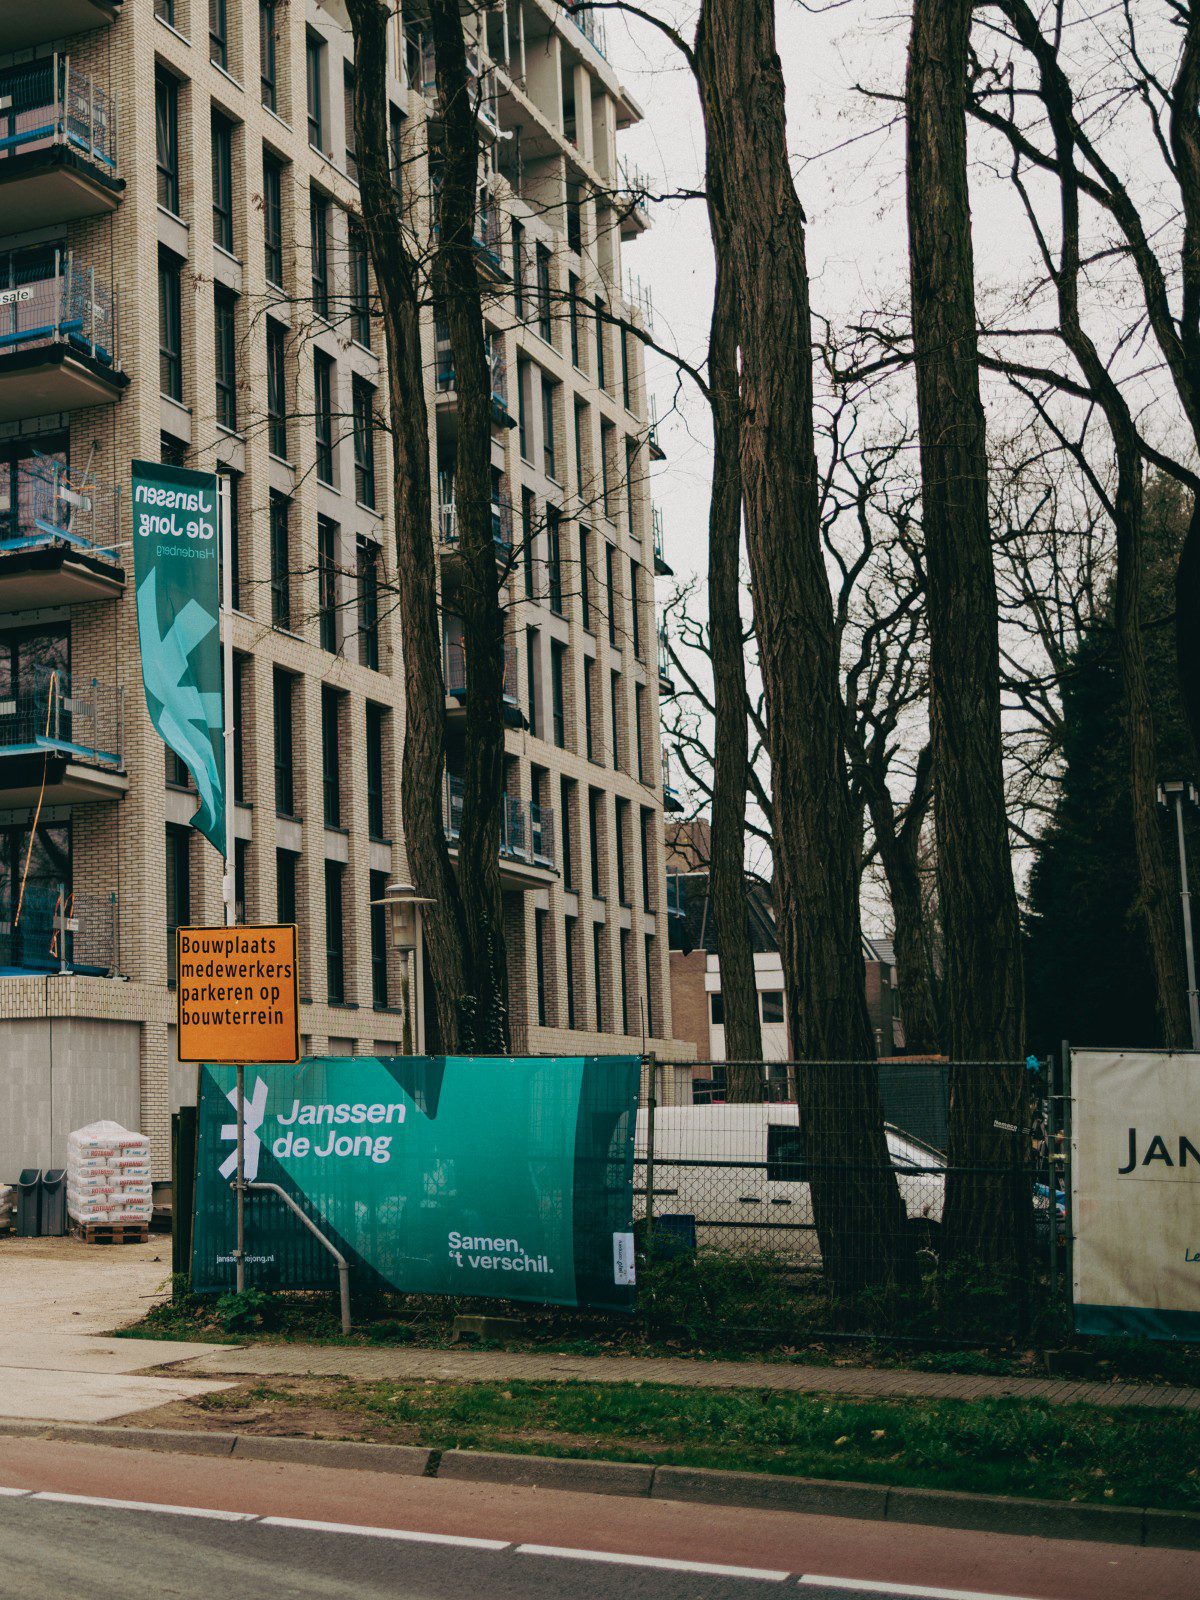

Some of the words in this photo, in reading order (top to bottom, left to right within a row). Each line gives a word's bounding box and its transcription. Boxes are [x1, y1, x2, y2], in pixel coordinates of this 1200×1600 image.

[2, 291, 29, 303] safe
[182, 936, 276, 958] Bouwplaats
[182, 960, 292, 978] medewerkers
[182, 983, 253, 1006] parkeren
[260, 986, 280, 1005] op
[182, 1006, 283, 1025] bouwterrein
[276, 1099, 406, 1126] Janssen
[272, 1131, 310, 1158] de
[314, 1130, 393, 1164] Jong
[448, 1231, 525, 1256] Samen,
[467, 1254, 554, 1274] verschil.
